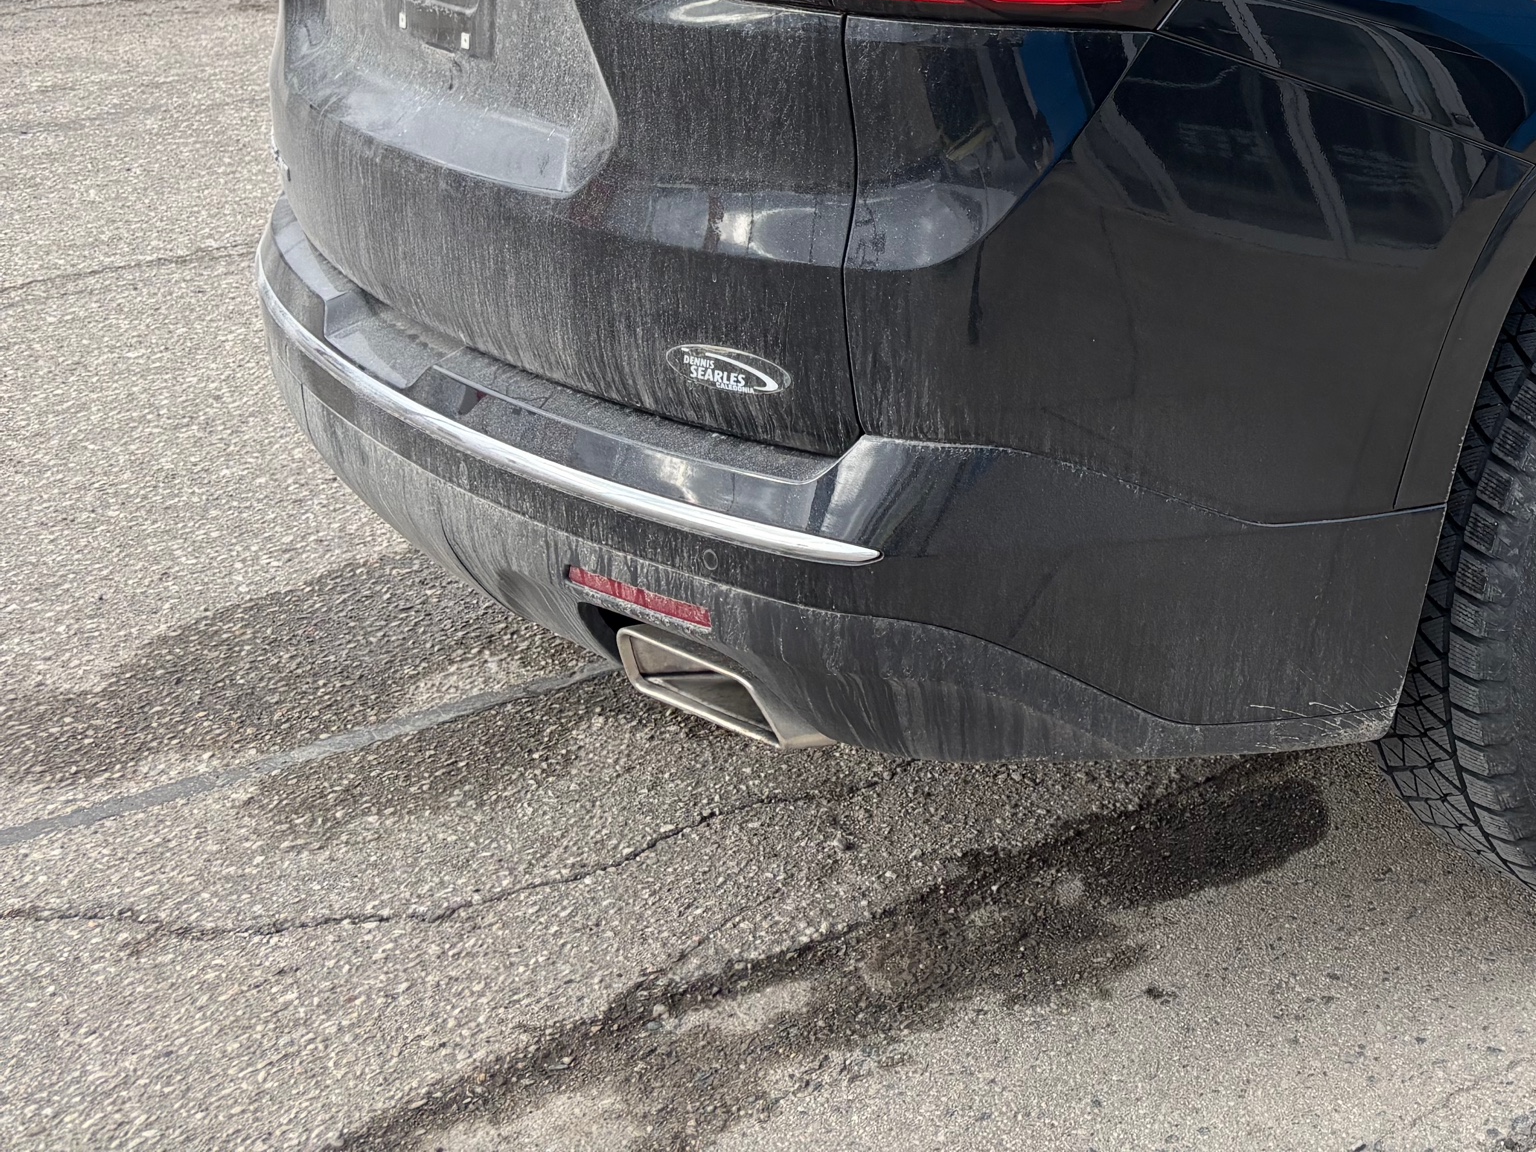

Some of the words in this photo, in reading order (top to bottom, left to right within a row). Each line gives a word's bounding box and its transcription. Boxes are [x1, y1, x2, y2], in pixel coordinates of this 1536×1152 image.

[683, 354, 715, 369] DENNIS
[689, 366, 746, 387] SEARLES
[715, 381, 755, 394] CALEDONIA
